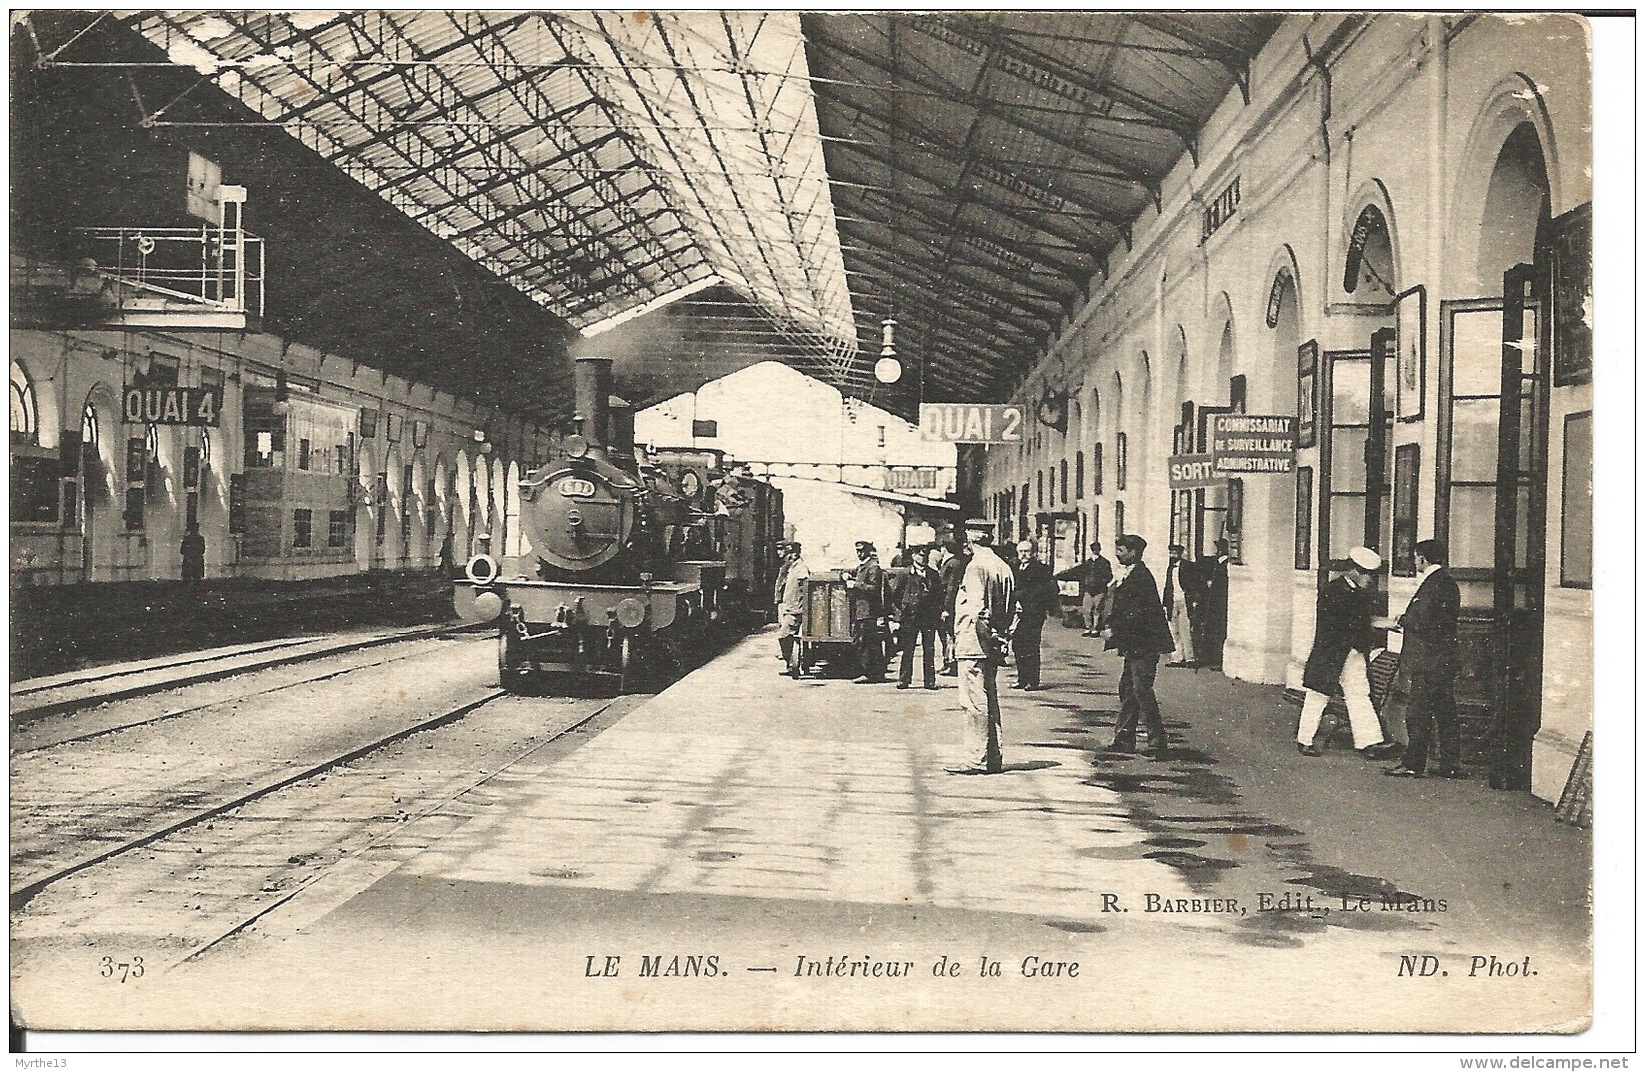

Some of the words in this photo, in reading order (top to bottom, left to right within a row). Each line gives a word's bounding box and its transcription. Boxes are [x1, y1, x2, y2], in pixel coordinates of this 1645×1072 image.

[125, 389, 181, 422] QUAI
[197, 391, 215, 422] 4
[921, 407, 990, 440] QUAI
[1002, 408, 1021, 440] 2
[1217, 418, 1291, 433] COMMISSARIAT
[1228, 439, 1293, 452] SURVEILLANCE
[1171, 461, 1226, 481] SORT
[1216, 457, 1291, 471] ADMINISTRATIVE
